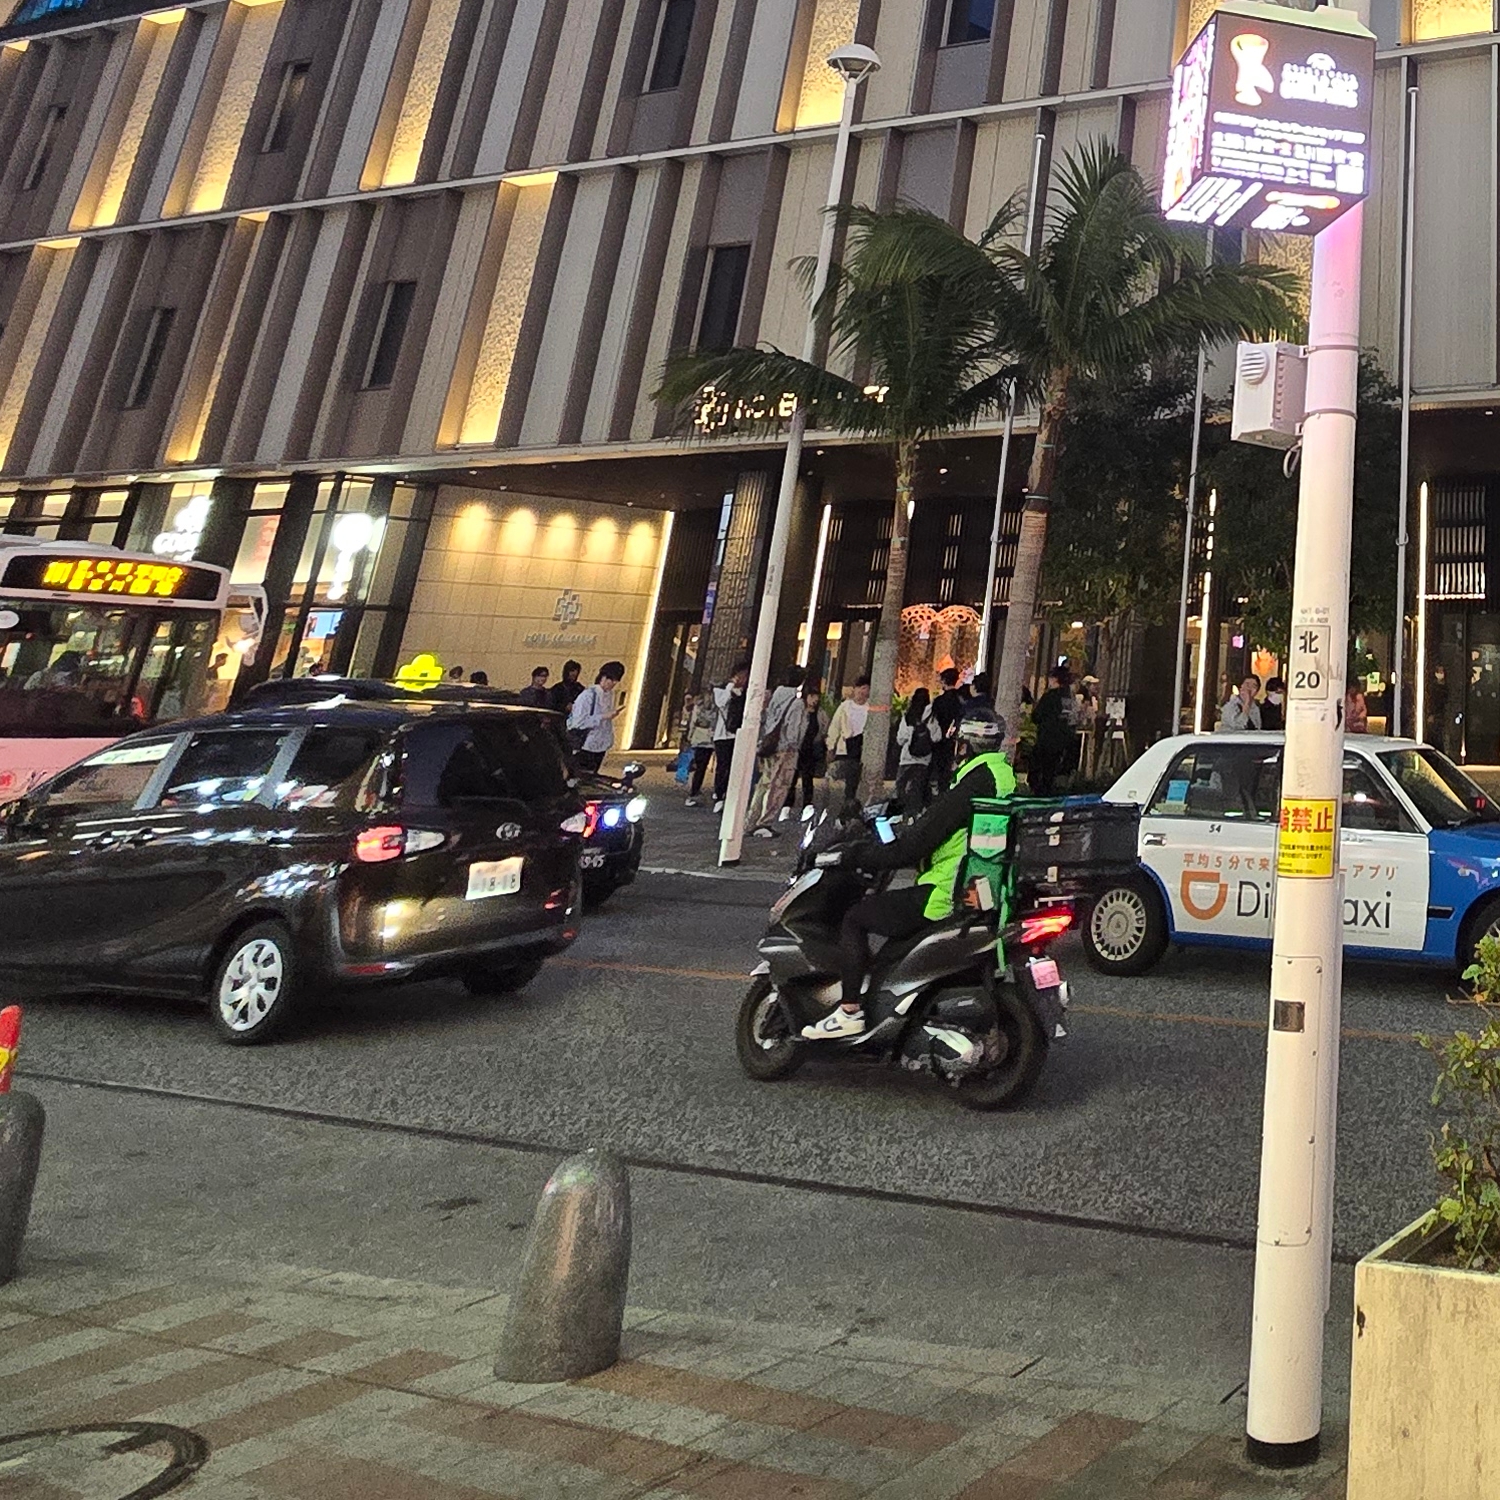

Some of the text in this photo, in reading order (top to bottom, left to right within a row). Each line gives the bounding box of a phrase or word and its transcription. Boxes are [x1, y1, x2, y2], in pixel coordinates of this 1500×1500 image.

[1299, 631, 1319, 653] 北
[1295, 671, 1320, 688] 20
[1209, 823, 1221, 833] 54
[1342, 891, 1391, 928] axi
